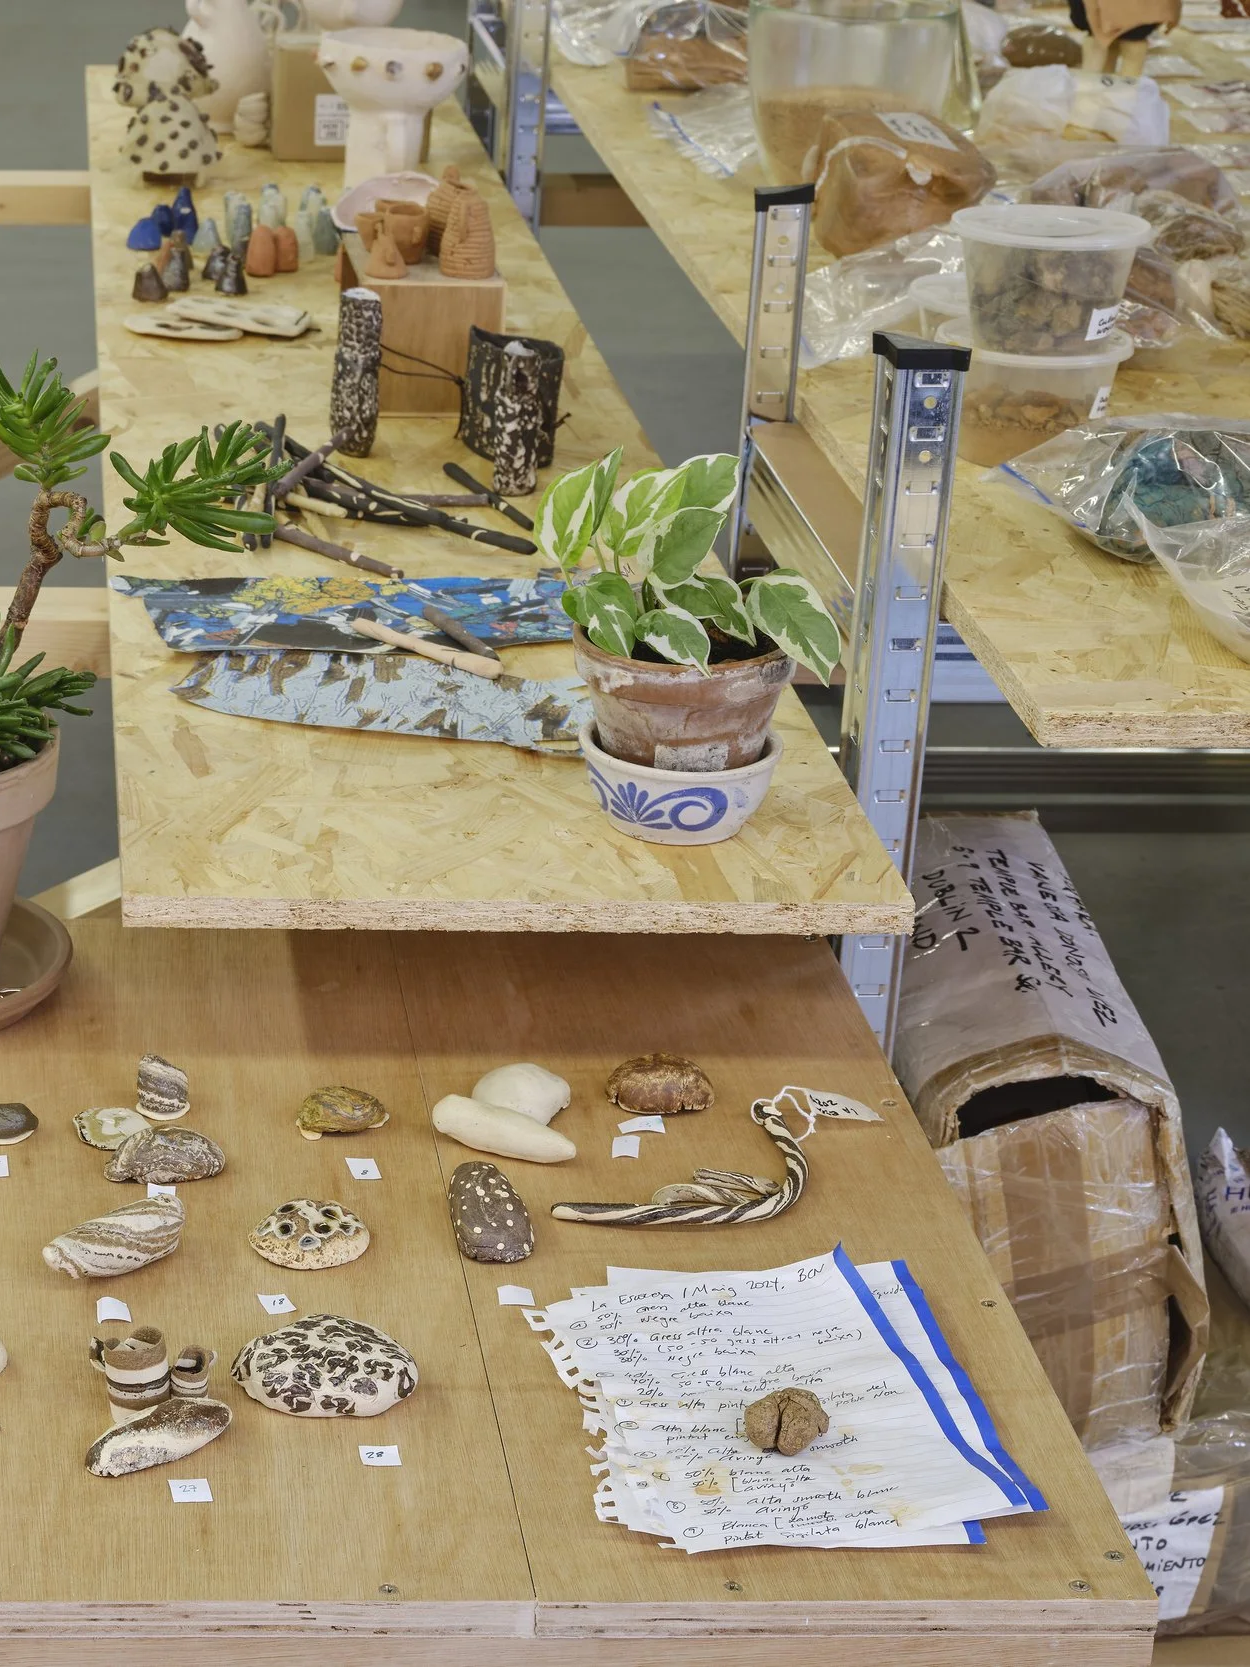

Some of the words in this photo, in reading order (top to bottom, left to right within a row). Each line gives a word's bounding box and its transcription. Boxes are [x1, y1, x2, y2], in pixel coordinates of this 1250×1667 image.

[985, 848, 1020, 897] TEMPLE
[968, 876, 1015, 932] TEMPLE
[997, 935, 1032, 966] BAR
[955, 926, 981, 952] 2
[591, 1300, 607, 1312] La
[692, 1284, 737, 1298] Maig
[797, 1263, 825, 1283] BCN
[272, 1298, 285, 1306] 18
[596, 1312, 622, 1323] 50%
[717, 1299, 753, 1307] blanc
[599, 1320, 623, 1331] 50%
[689, 1310, 733, 1319] baixa
[649, 1332, 683, 1343] Gress
[733, 1325, 773, 1336] blanc
[715, 1347, 756, 1356] baixa
[718, 1365, 753, 1377] blanc
[765, 1364, 795, 1374] alta
[637, 1387, 664, 1399] 20%
[690, 1424, 727, 1433] blanc
[365, 1450, 384, 1459] 28
[683, 1467, 716, 1479] 50%
[728, 1468, 772, 1477] blanc
[781, 1464, 812, 1473] alta
[179, 1484, 198, 1493] 27
[746, 1495, 783, 1505] alta
[856, 1486, 900, 1499] blanc
[702, 1506, 732, 1516] 50%
[721, 1521, 769, 1531] Blanca
[855, 1518, 902, 1530] blanca
